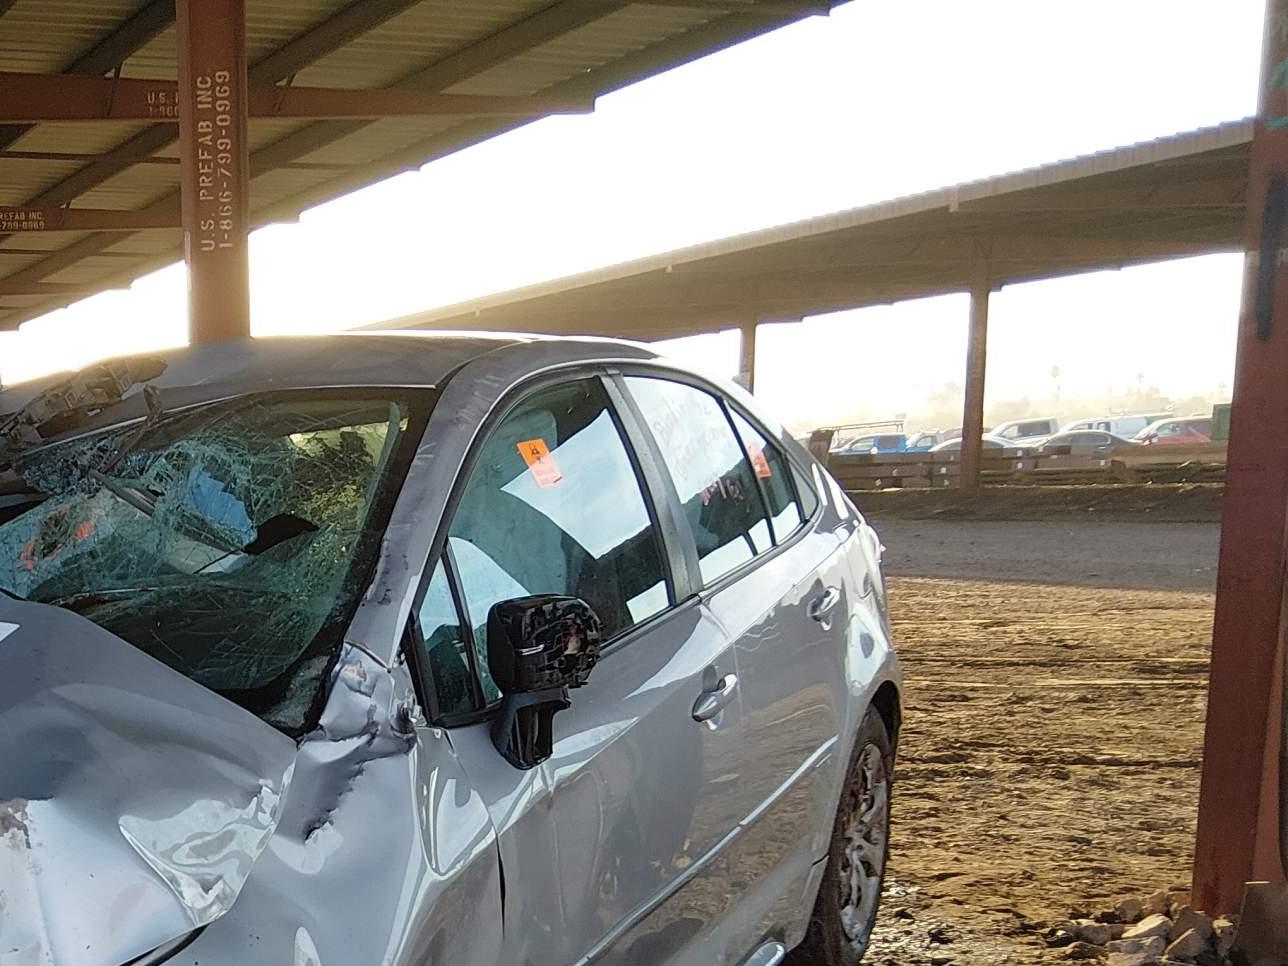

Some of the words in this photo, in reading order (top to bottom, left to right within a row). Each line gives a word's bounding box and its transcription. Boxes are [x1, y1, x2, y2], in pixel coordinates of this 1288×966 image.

[196, 75, 212, 109] INC
[198, 120, 214, 201] PREFAB
[215, 70, 233, 249] 1-866-799-0969
[200, 215, 216, 251] U.S.
